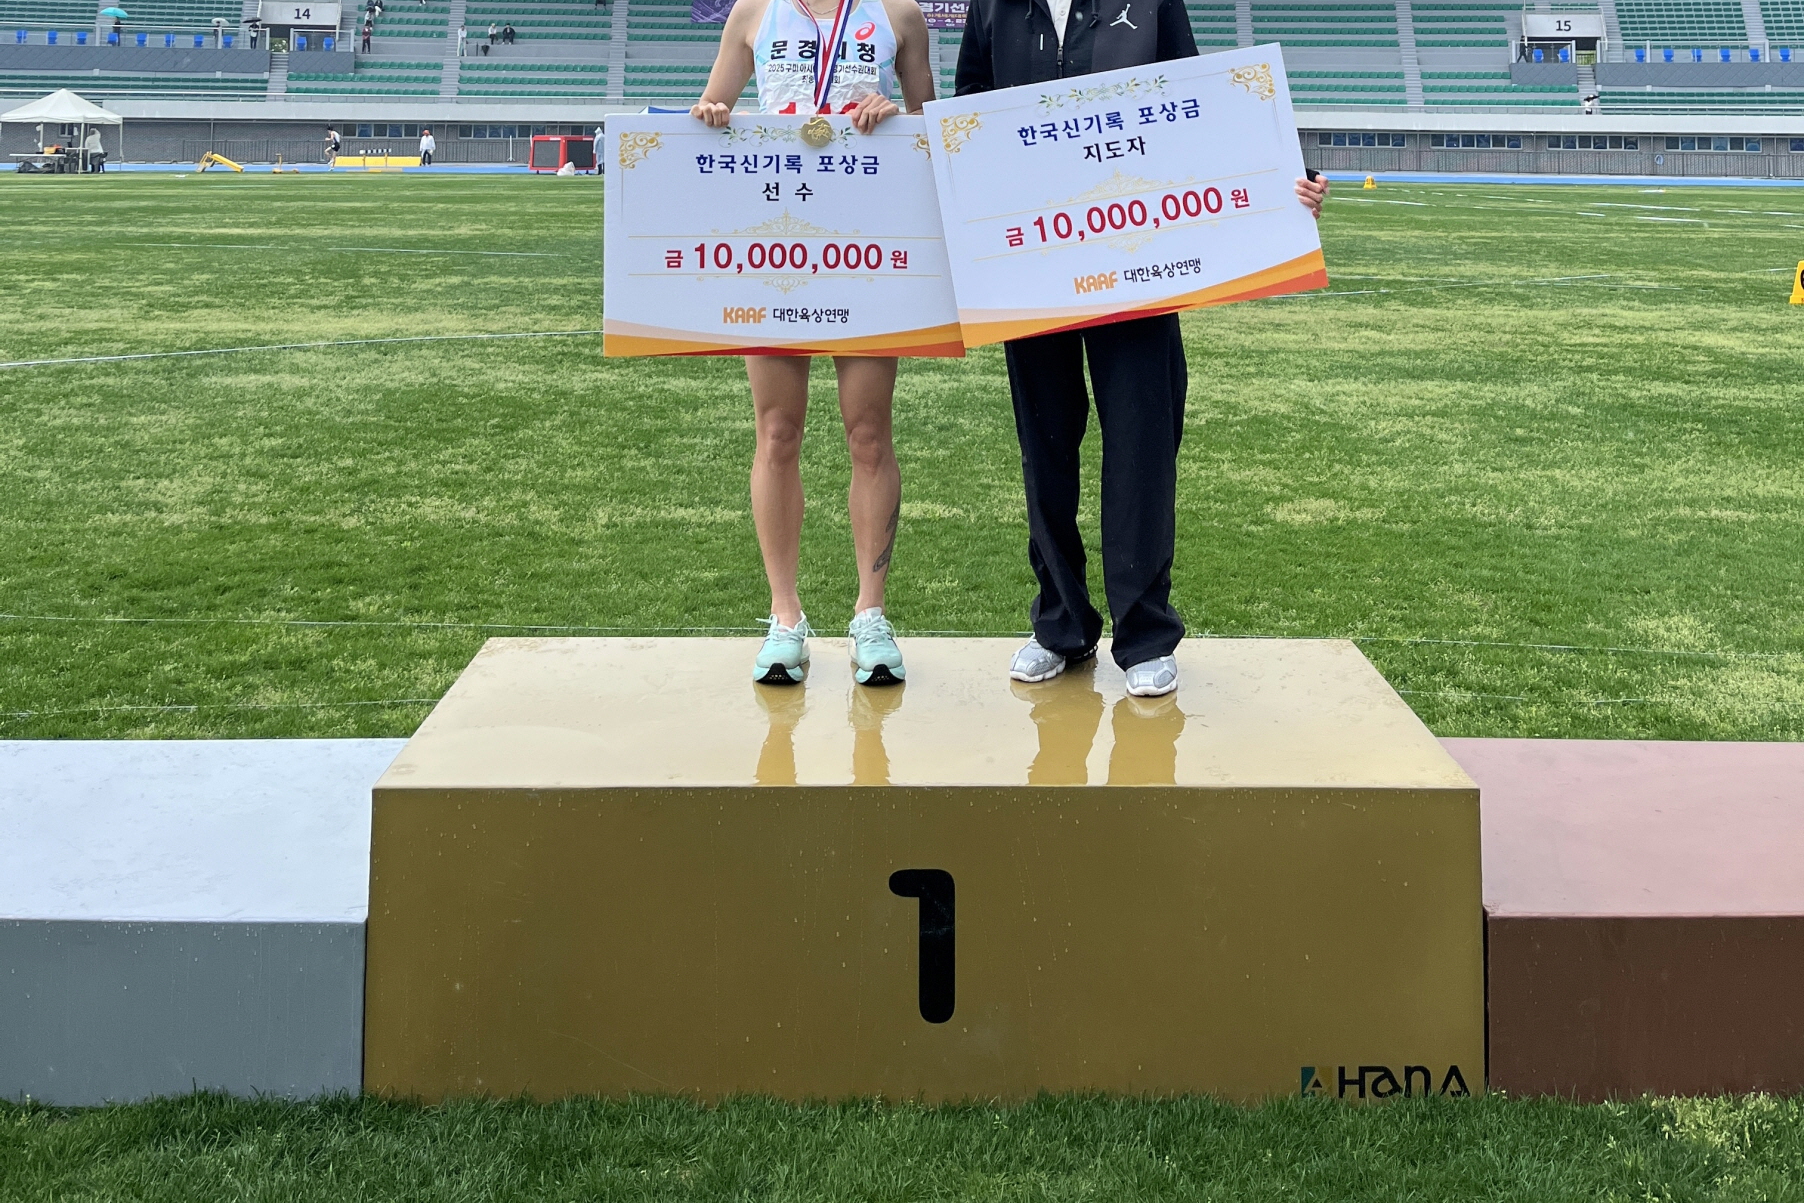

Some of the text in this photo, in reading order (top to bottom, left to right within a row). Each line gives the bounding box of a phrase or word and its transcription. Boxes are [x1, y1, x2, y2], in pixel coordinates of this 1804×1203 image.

[294, 8, 311, 19] 14
[919, 2, 969, 13] 경기선
[1556, 20, 1572, 32] 15
[767, 63, 785, 73] 2025
[785, 63, 799, 73] 구미
[1017, 98, 1200, 147] 한국신기록 포상금
[1083, 135, 1146, 163] 지도자
[695, 154, 880, 175] 한국신기록 포상금
[1005, 187, 1250, 248] 금 10,000,000 원
[664, 242, 909, 274] 금 10,000,000 원
[1073, 257, 1201, 295] KAAF 대한육상연맹
[723, 306, 850, 324] KAAF 대한육상연맹
[888, 869, 956, 1024] 1
